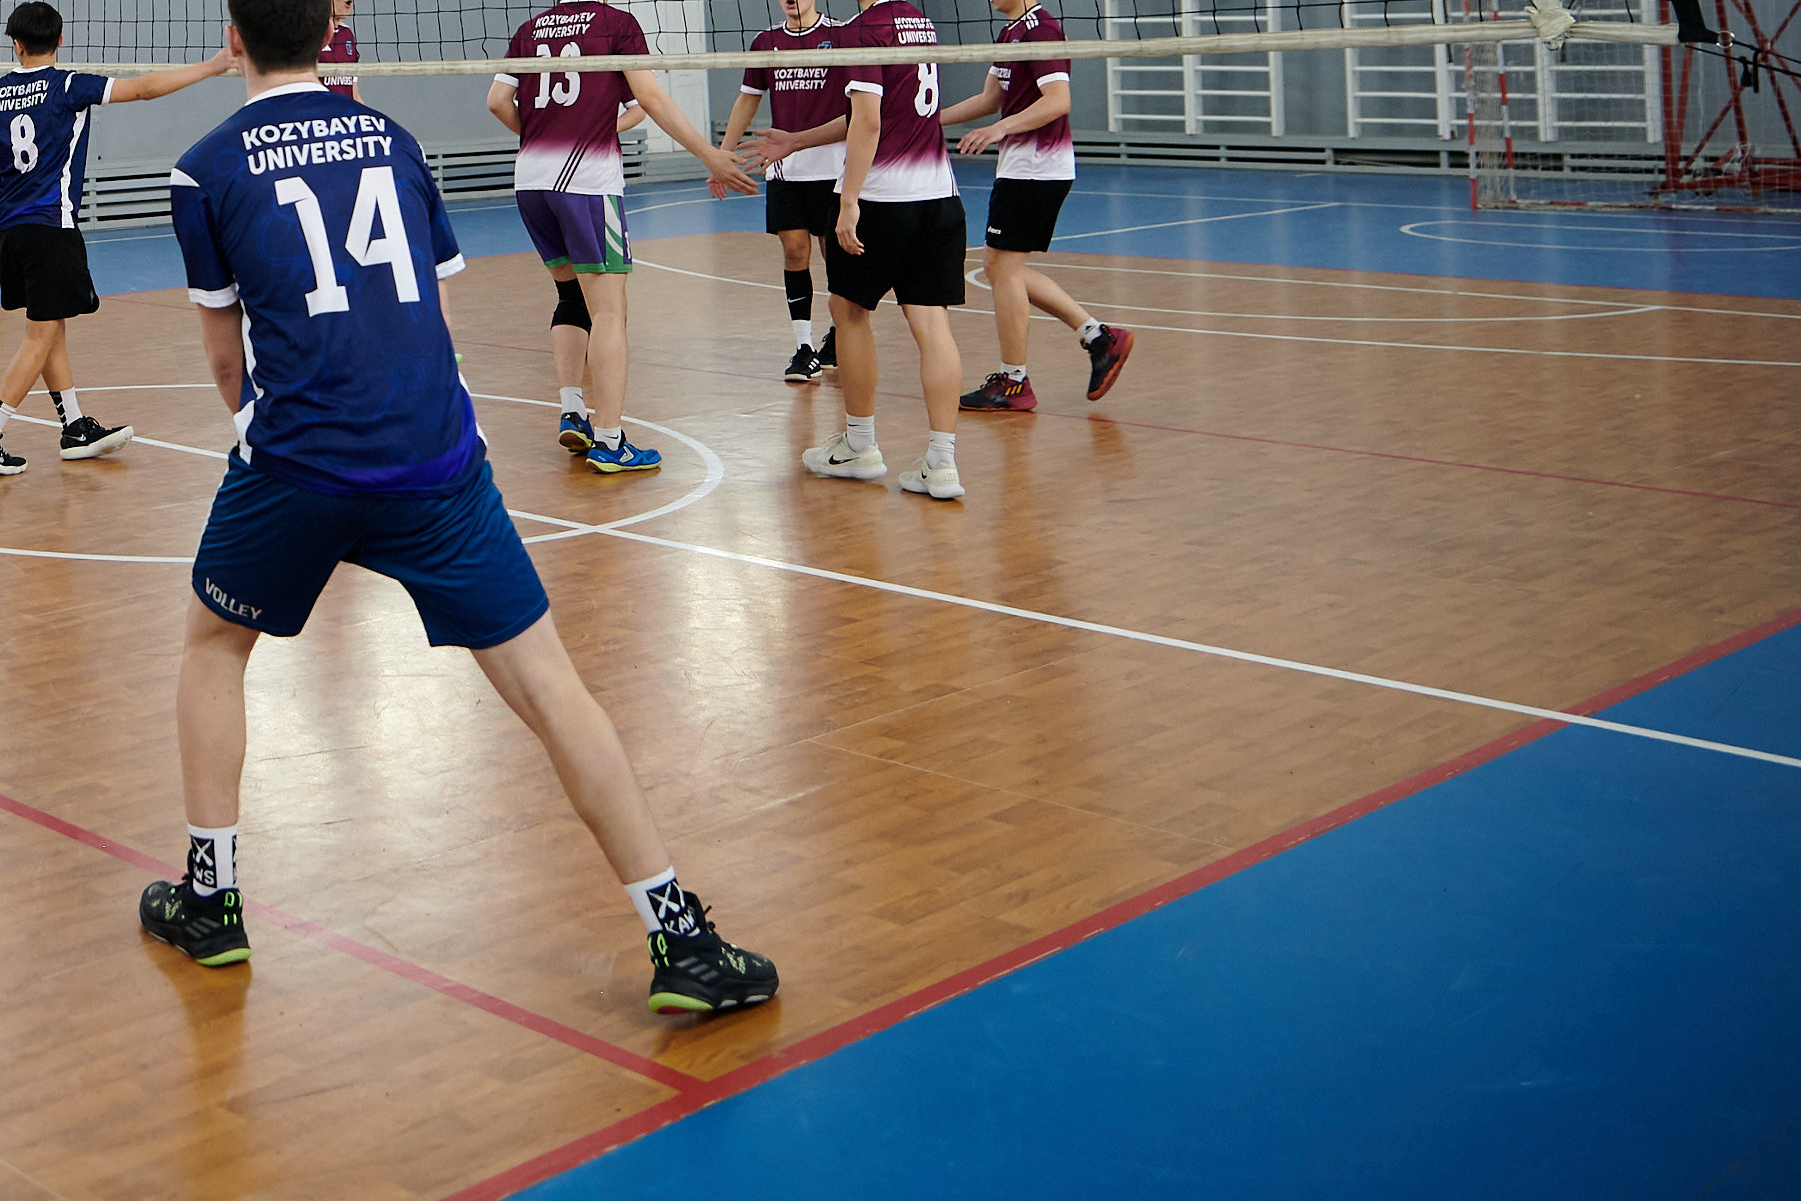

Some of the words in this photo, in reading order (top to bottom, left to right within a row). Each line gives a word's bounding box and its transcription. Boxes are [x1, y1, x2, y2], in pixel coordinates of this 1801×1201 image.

[535, 11, 596, 28] KOZYBAYEV
[898, 31, 937, 45] UNIVERSIT
[534, 41, 581, 109] 13
[9, 113, 39, 175] 8
[242, 115, 386, 150] KOZYBAYEV
[247, 136, 393, 175] UNIVERSITY
[274, 165, 421, 318] 14
[205, 577, 263, 620] VOLLEY
